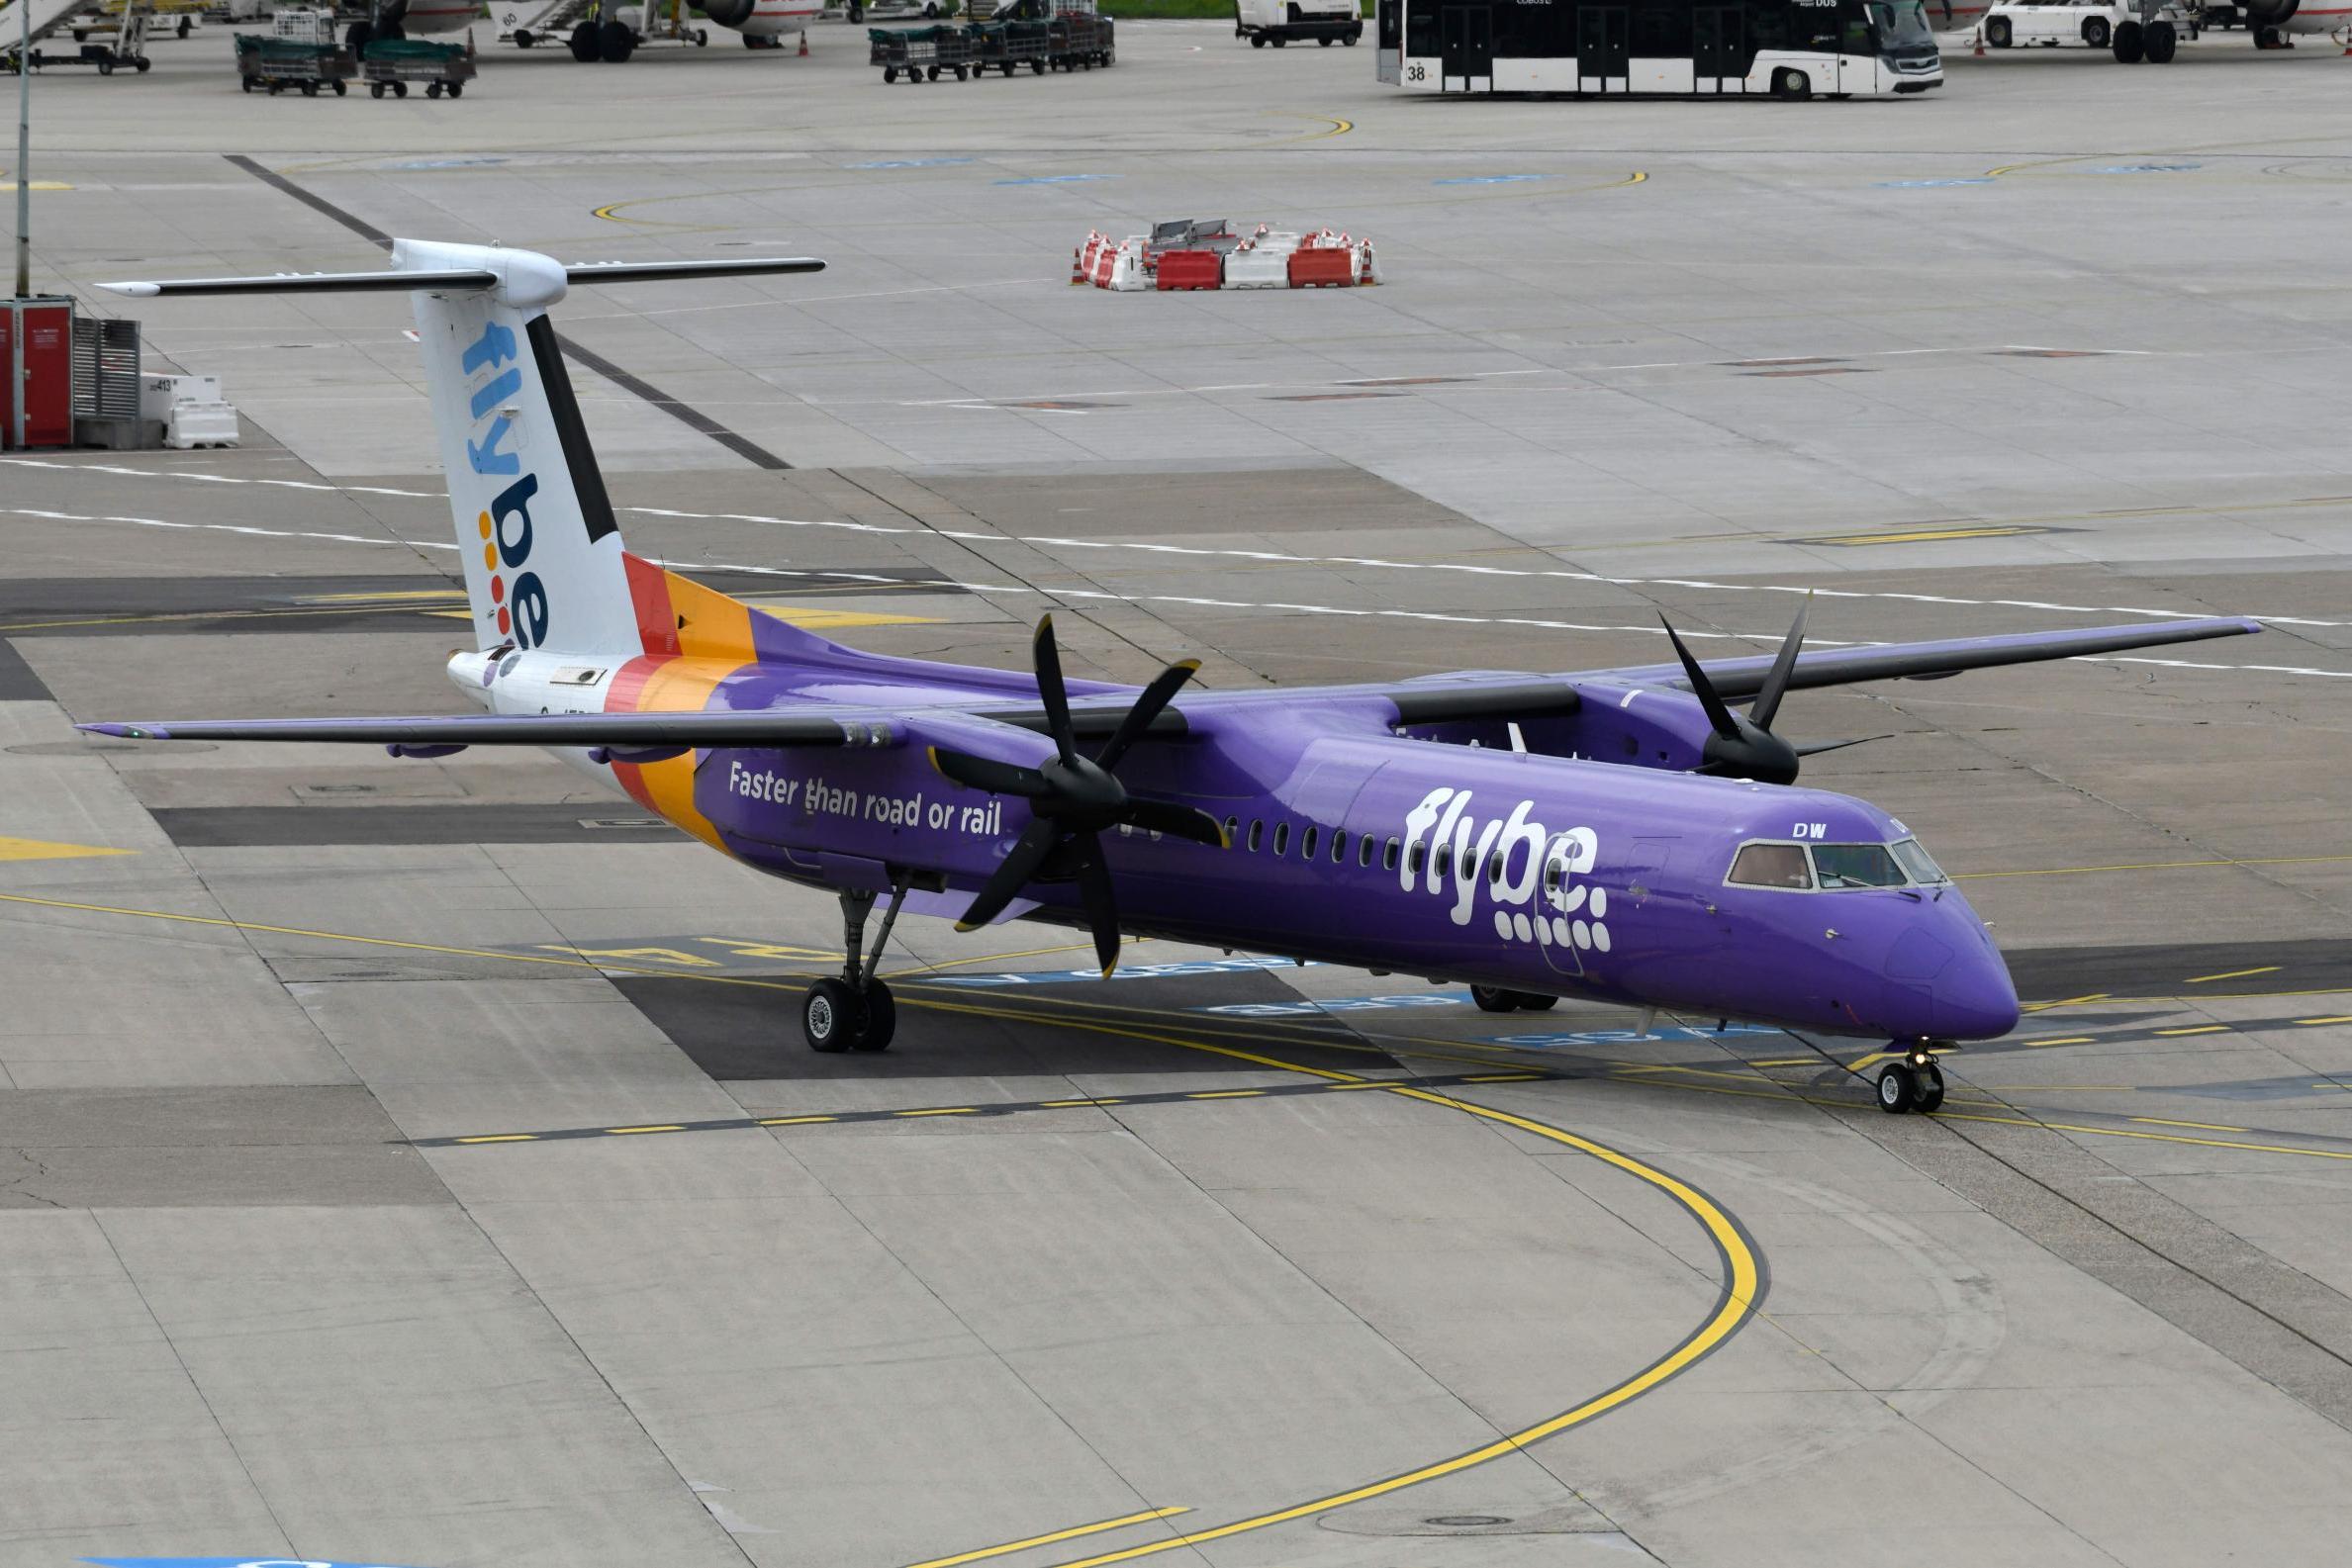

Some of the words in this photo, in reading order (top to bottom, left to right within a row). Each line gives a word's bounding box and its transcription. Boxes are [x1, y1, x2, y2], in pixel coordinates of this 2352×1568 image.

[1407, 66, 1425, 81] 38
[461, 321, 549, 651] flybe
[728, 761, 799, 805] Faster
[805, 777, 858, 818] than
[864, 791, 922, 828] road
[928, 801, 955, 830] or
[960, 799, 1001, 836] rail
[1792, 823, 1827, 839] DW
[1399, 786, 1598, 926] flybe
